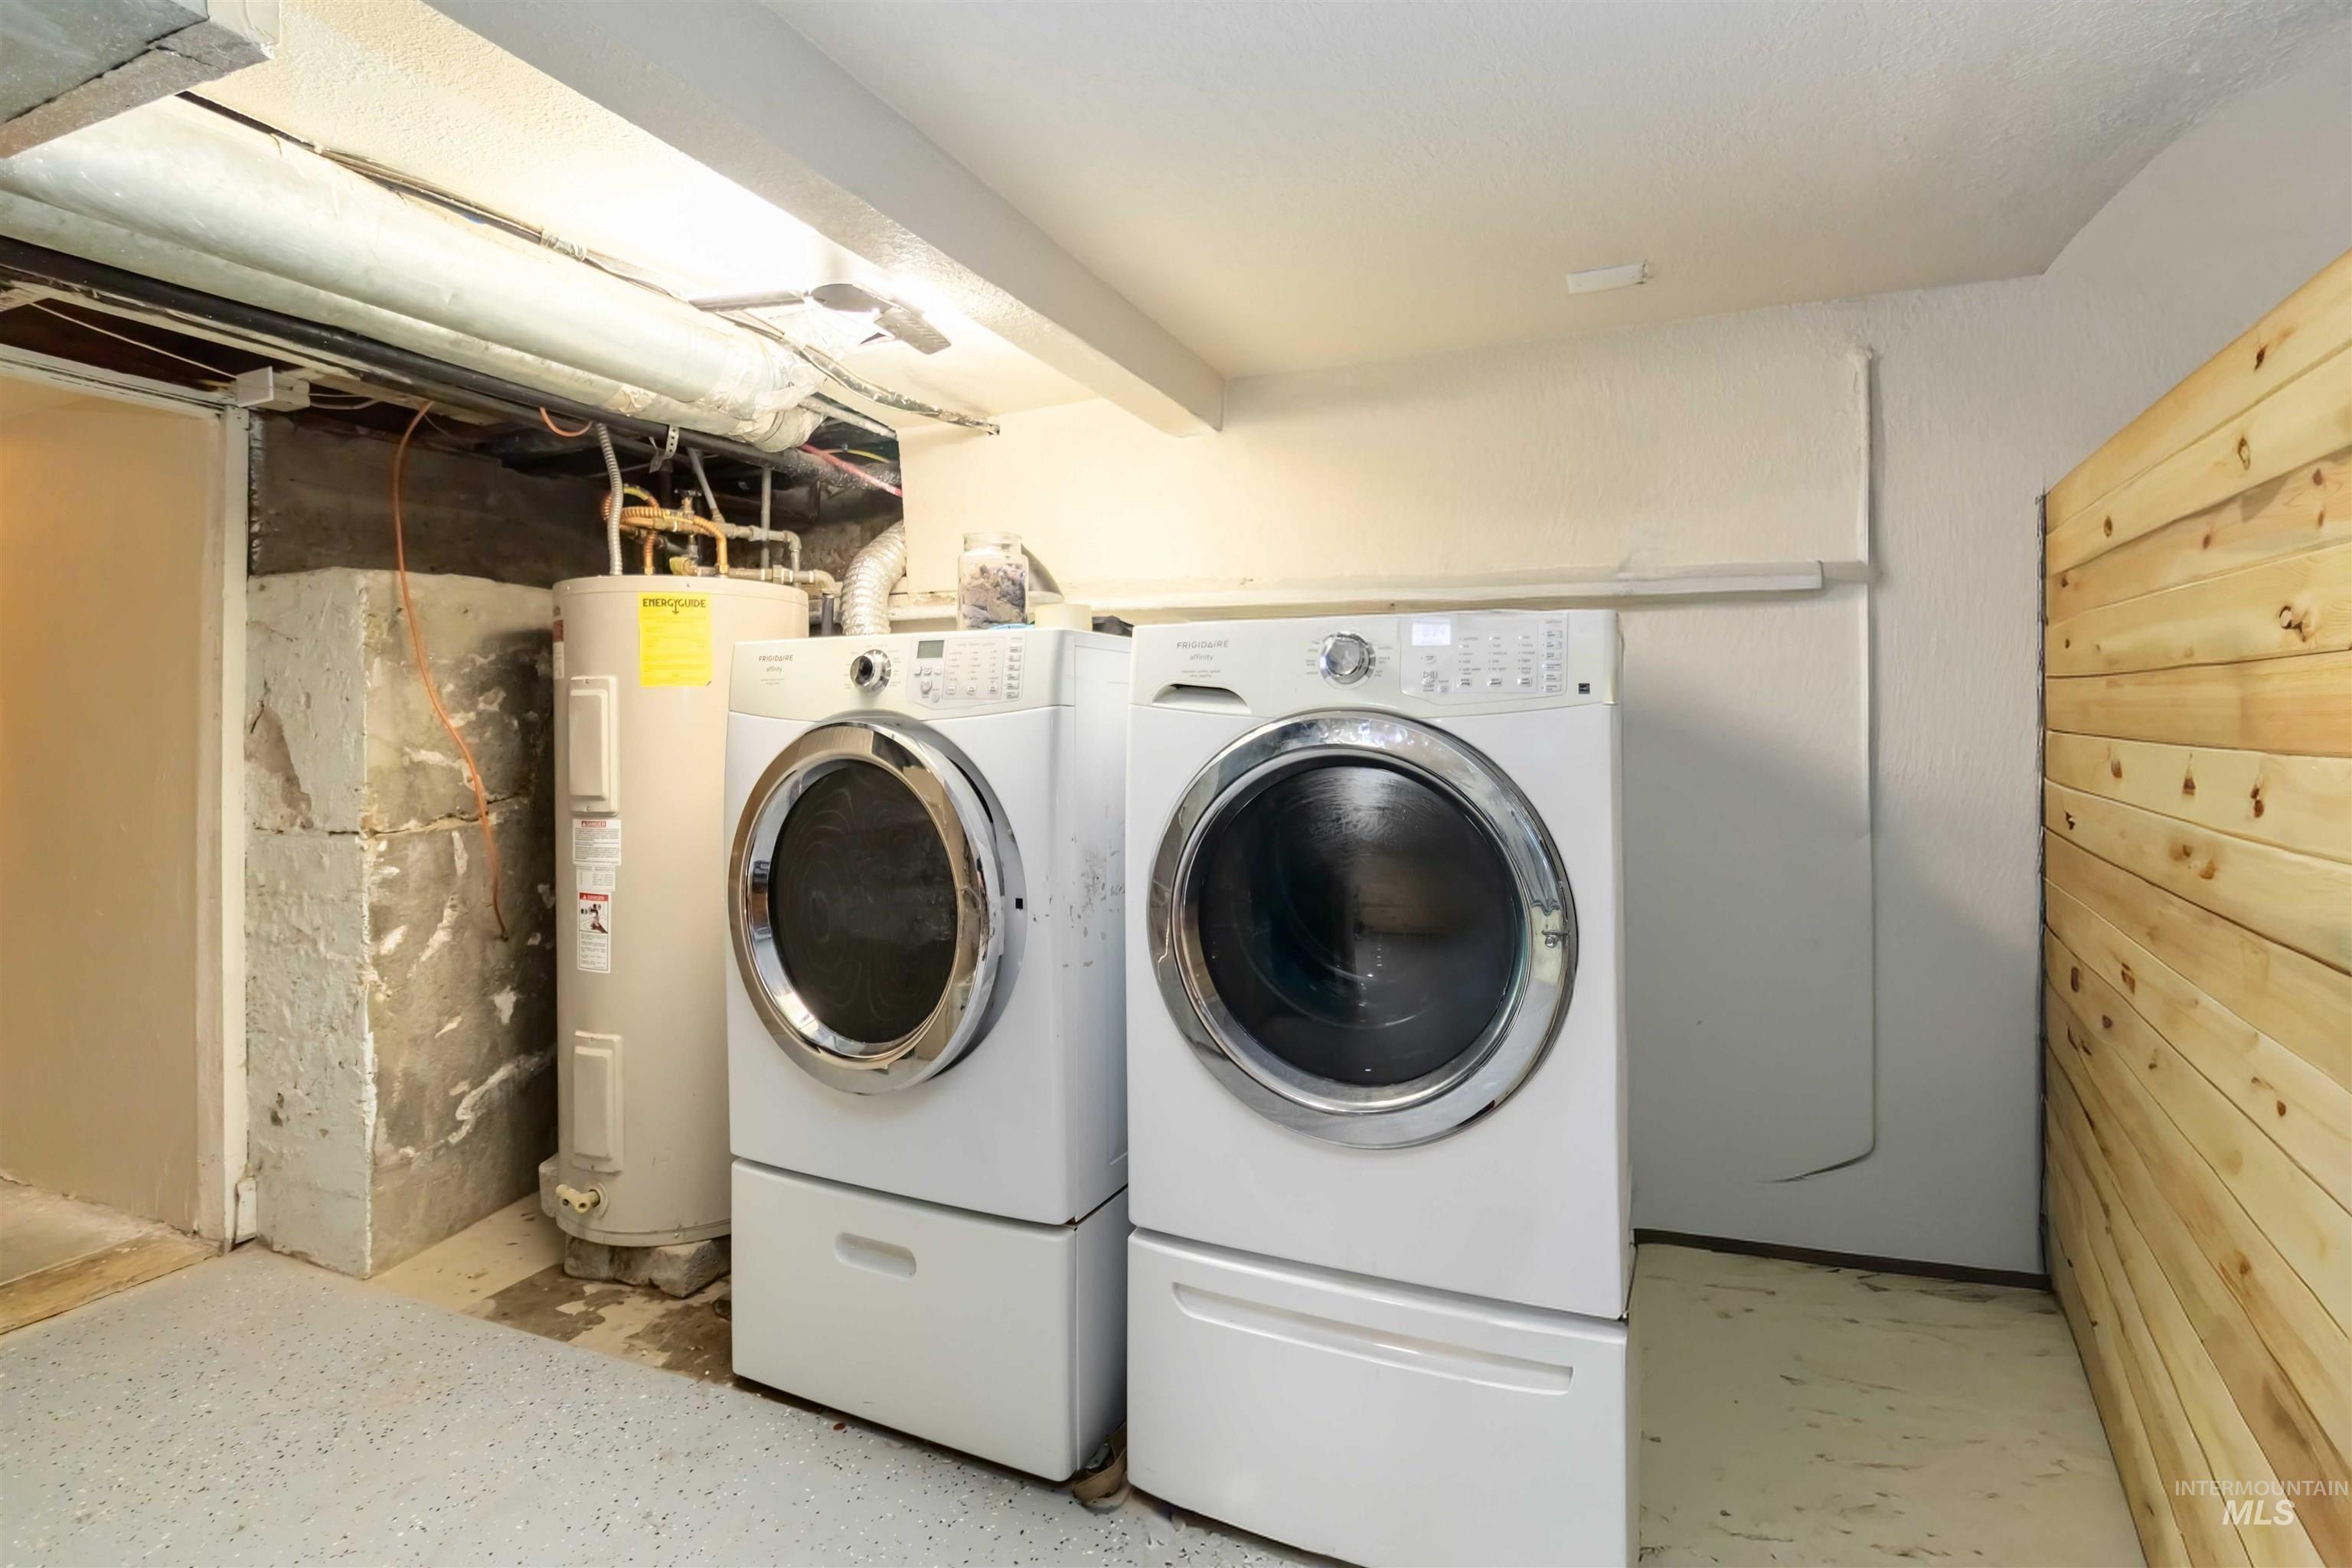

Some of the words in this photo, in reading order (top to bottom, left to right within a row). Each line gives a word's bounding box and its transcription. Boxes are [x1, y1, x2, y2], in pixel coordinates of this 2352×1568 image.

[642, 598, 707, 610] ENERGYGUIDE
[1176, 640, 1229, 649] FRIGIDAIRE
[1189, 653, 1214, 662] affinity
[766, 665, 783, 674] affinity
